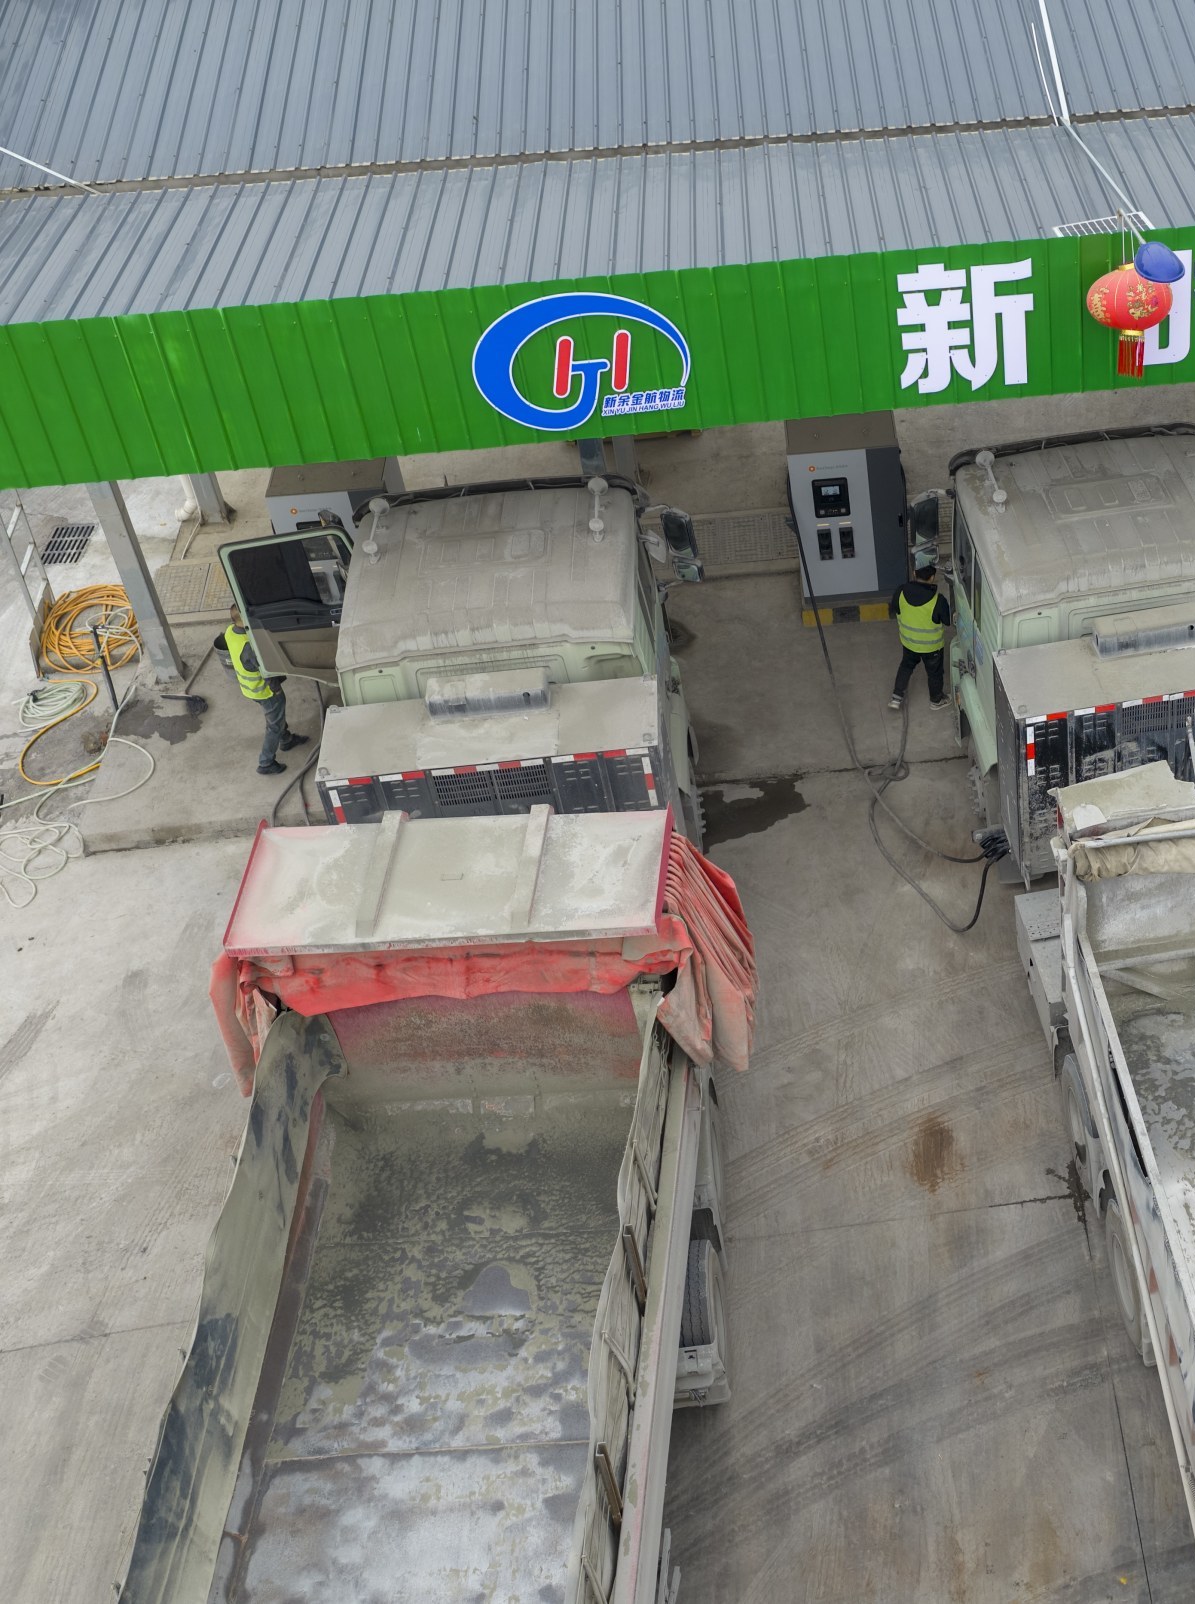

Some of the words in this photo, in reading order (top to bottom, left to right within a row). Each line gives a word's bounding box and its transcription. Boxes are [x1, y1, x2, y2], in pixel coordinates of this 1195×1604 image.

[603, 388, 684, 409] 新余金航物流
[602, 408, 615, 416] XIN
[627, 405, 638, 413] JIN
[638, 403, 659, 412] HANG
[660, 401, 672, 409] WU
[673, 400, 685, 408] LIU
